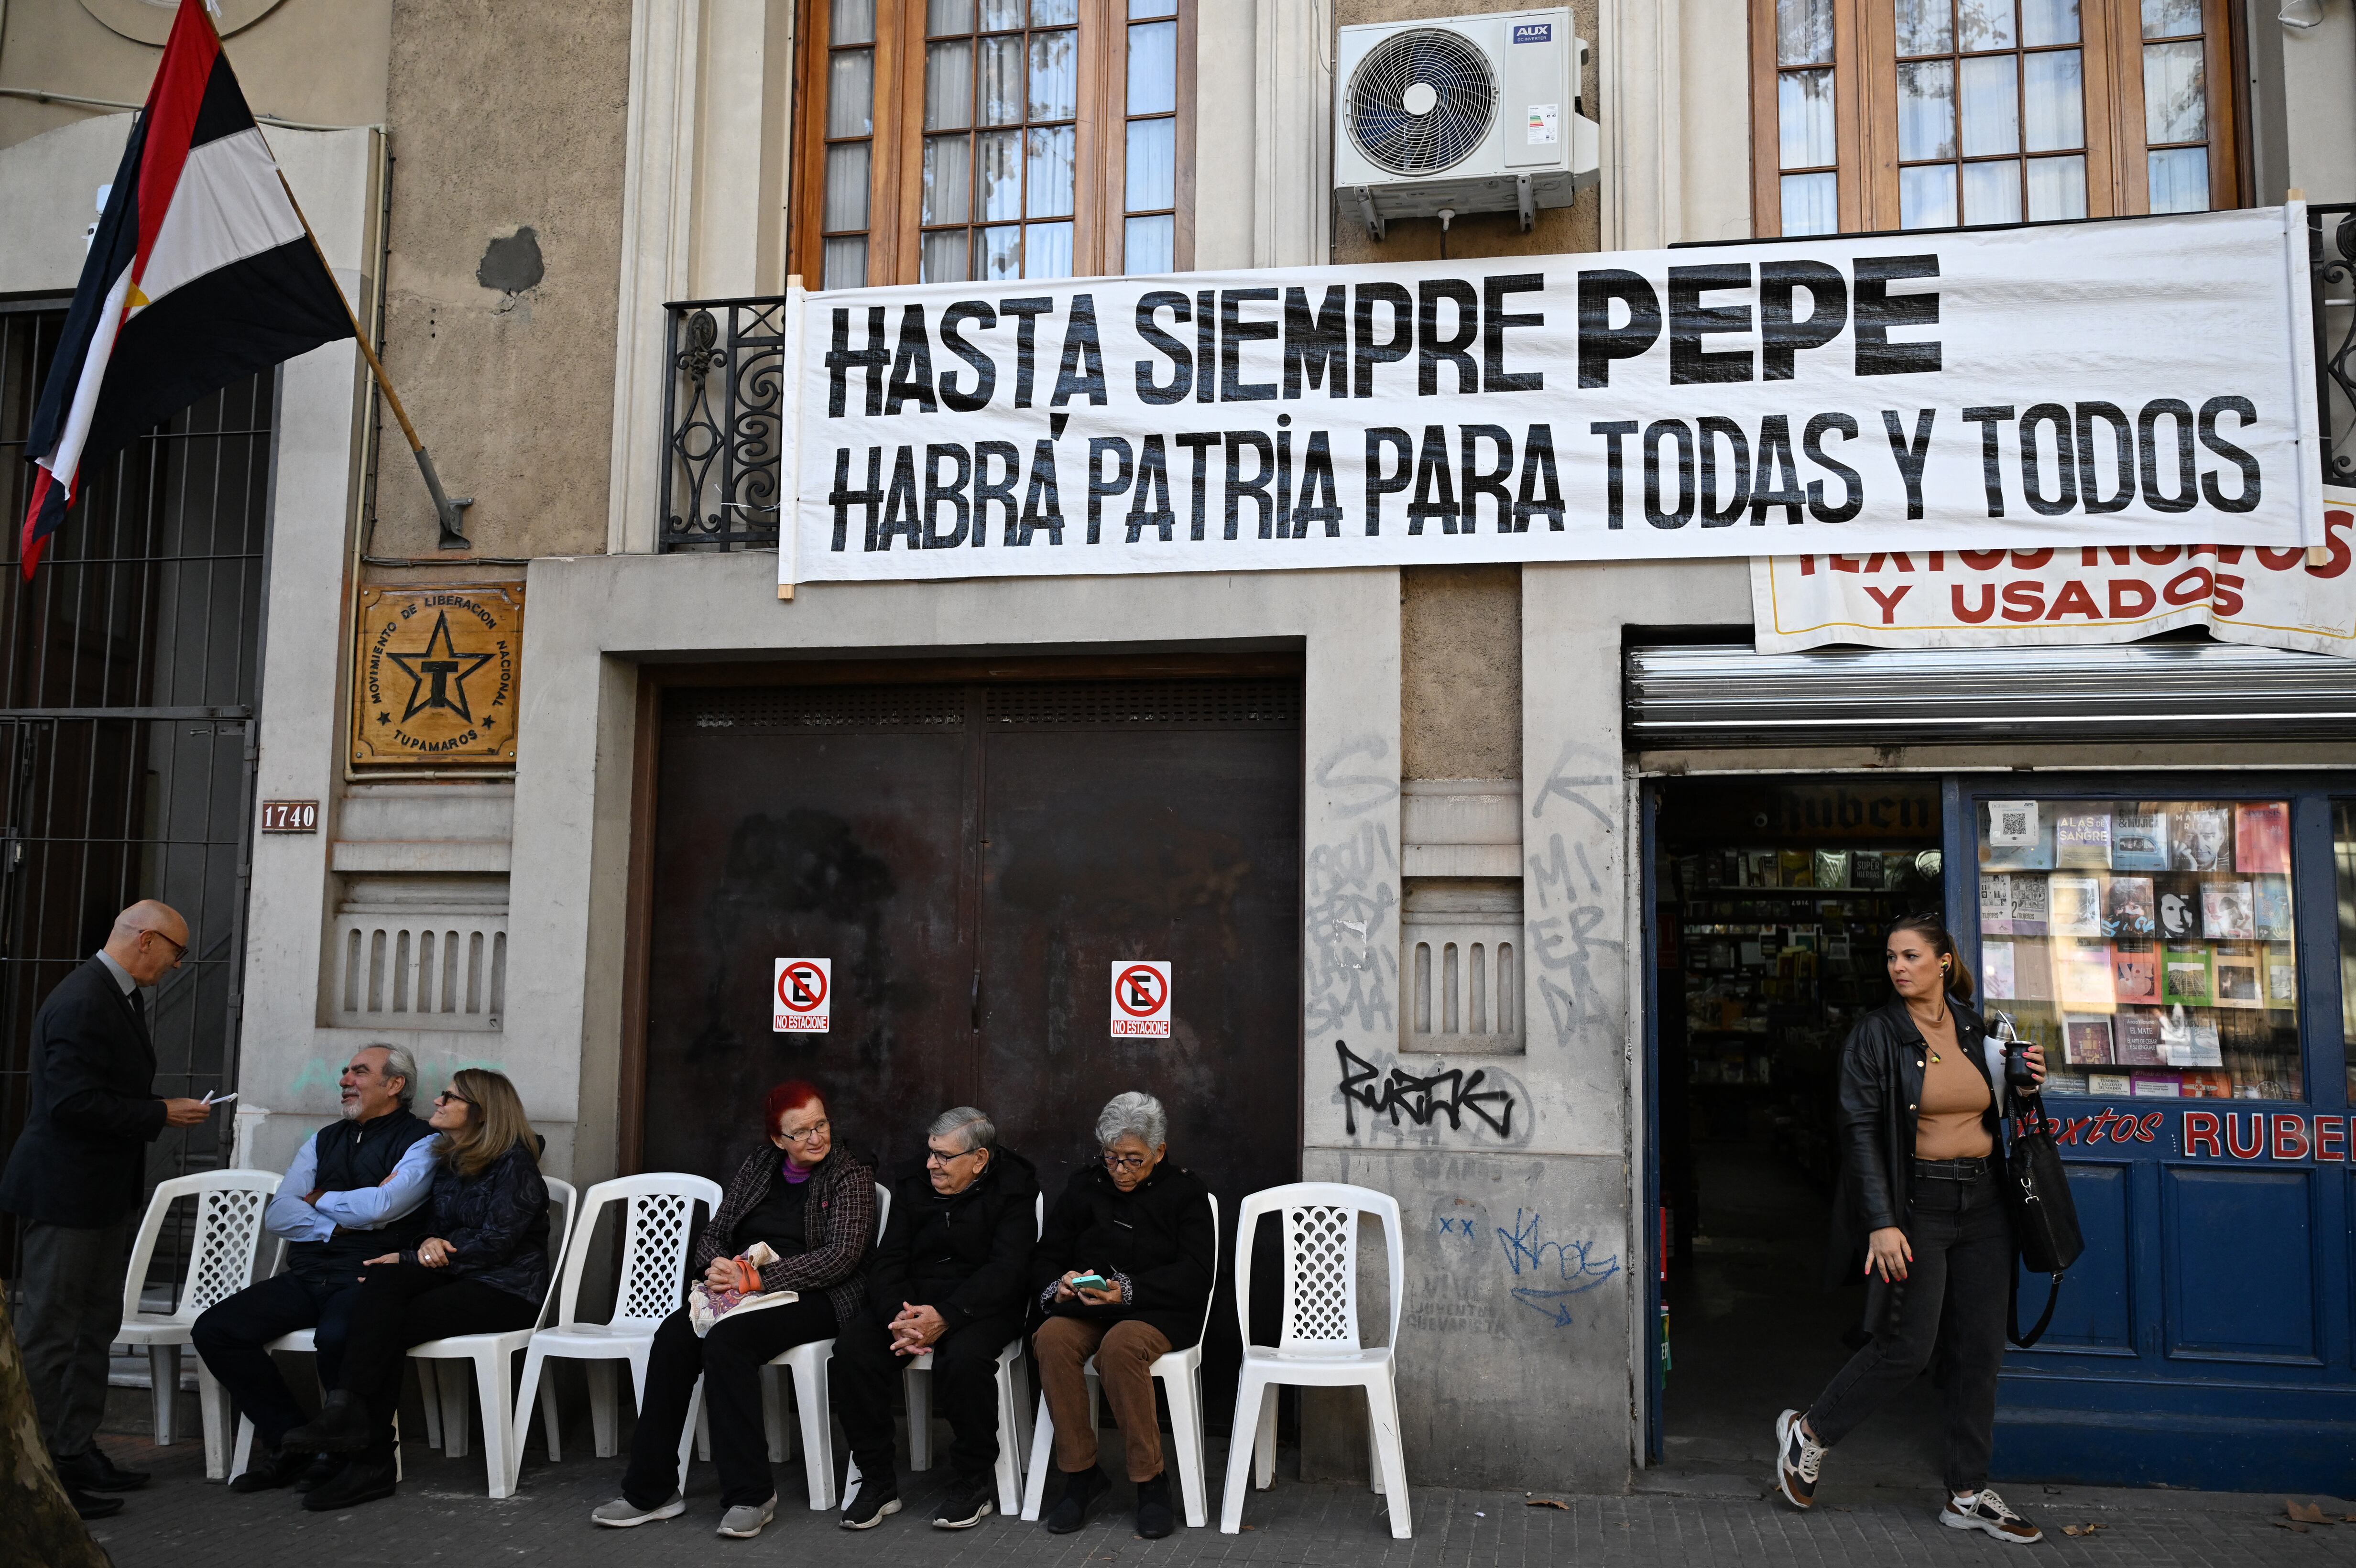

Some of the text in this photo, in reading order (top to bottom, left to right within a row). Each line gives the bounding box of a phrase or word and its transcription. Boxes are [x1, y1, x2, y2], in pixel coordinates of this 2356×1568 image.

[1516, 26, 1548, 36] AUX
[825, 254, 1942, 417] HASTA SIEMPRE PEPE
[829, 413, 1064, 552] HABRÁ
[1365, 424, 1566, 537] PARA
[1591, 412, 1864, 530] TODAS
[1883, 409, 1936, 521] Y
[1963, 396, 2260, 518] TODOS
[1864, 566, 2245, 624] Y USADOS
[369, 596, 511, 707] MOVIMIENTO DE LIBERACION NACIONAL
[393, 730, 478, 751] TUPAMAROS
[264, 806, 314, 827] 1740
[2061, 817, 2094, 827] ALAS
[2060, 830, 2107, 842] SANGRE
[1857, 861, 1879, 870] SUPER
[2018, 911, 2034, 920] mujeres
[776, 1015, 827, 1029] NO ESTACIONE
[1114, 1021, 1167, 1034] NO ESTACIONE
[2183, 1111, 2356, 1162] RUBE
